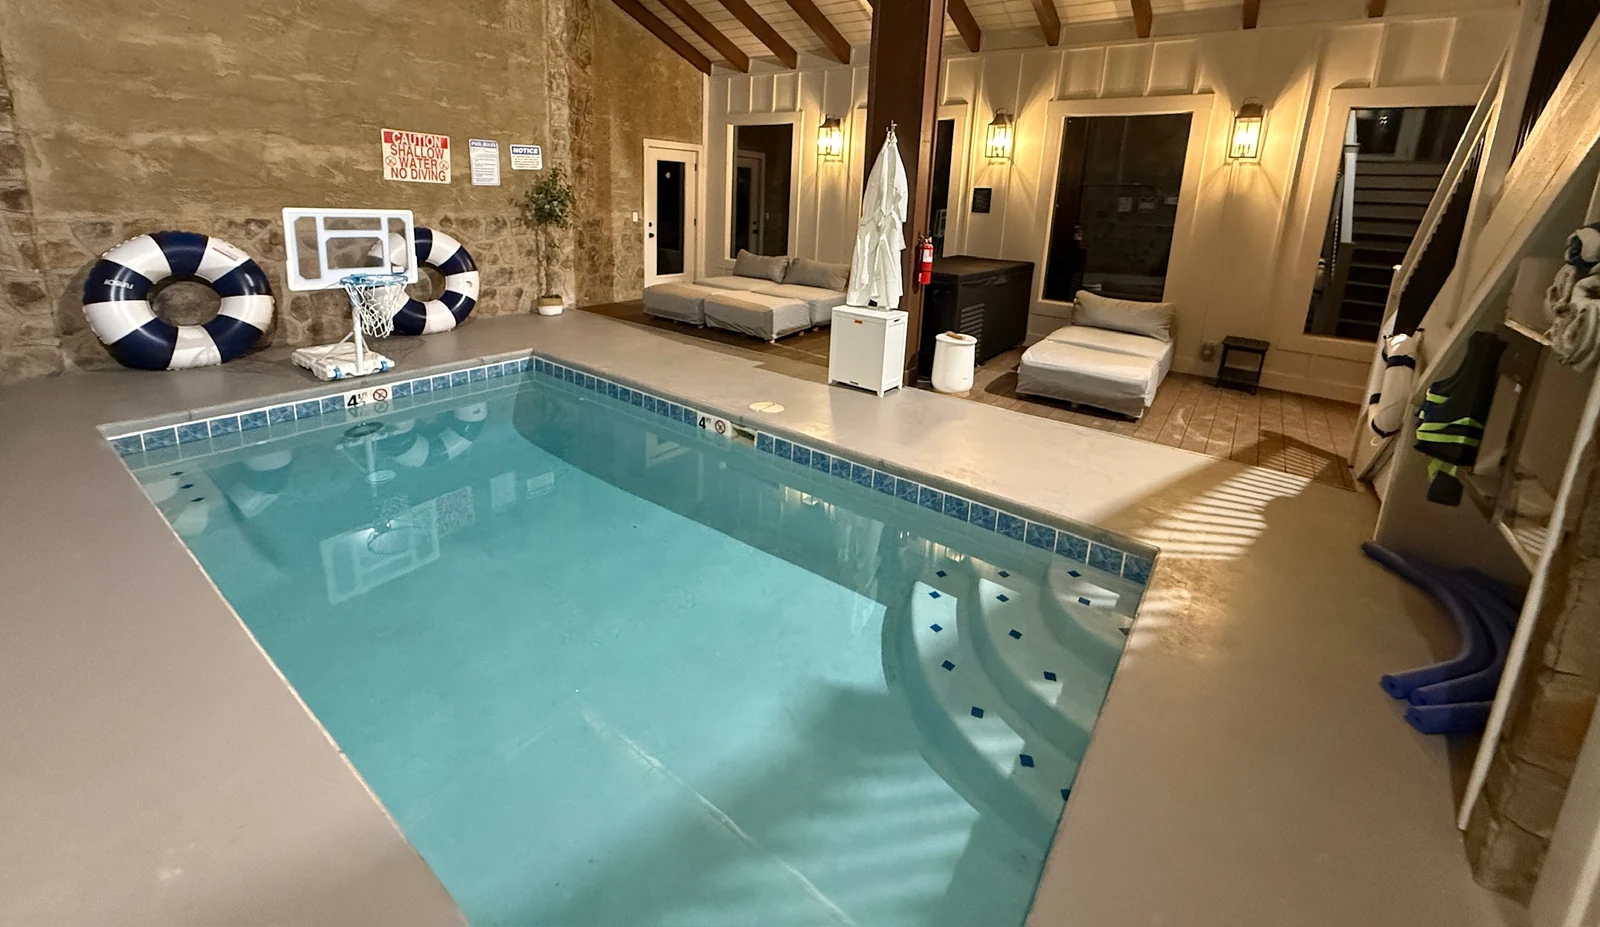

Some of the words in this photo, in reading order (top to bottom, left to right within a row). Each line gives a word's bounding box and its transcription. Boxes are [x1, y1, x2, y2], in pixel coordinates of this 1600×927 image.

[392, 132, 441, 149] CAUTION
[390, 143, 444, 160] SHALLOW
[512, 147, 538, 155] NOTICE
[399, 156, 437, 170] WATER
[391, 167, 407, 179] NO
[411, 168, 446, 182] DIVING
